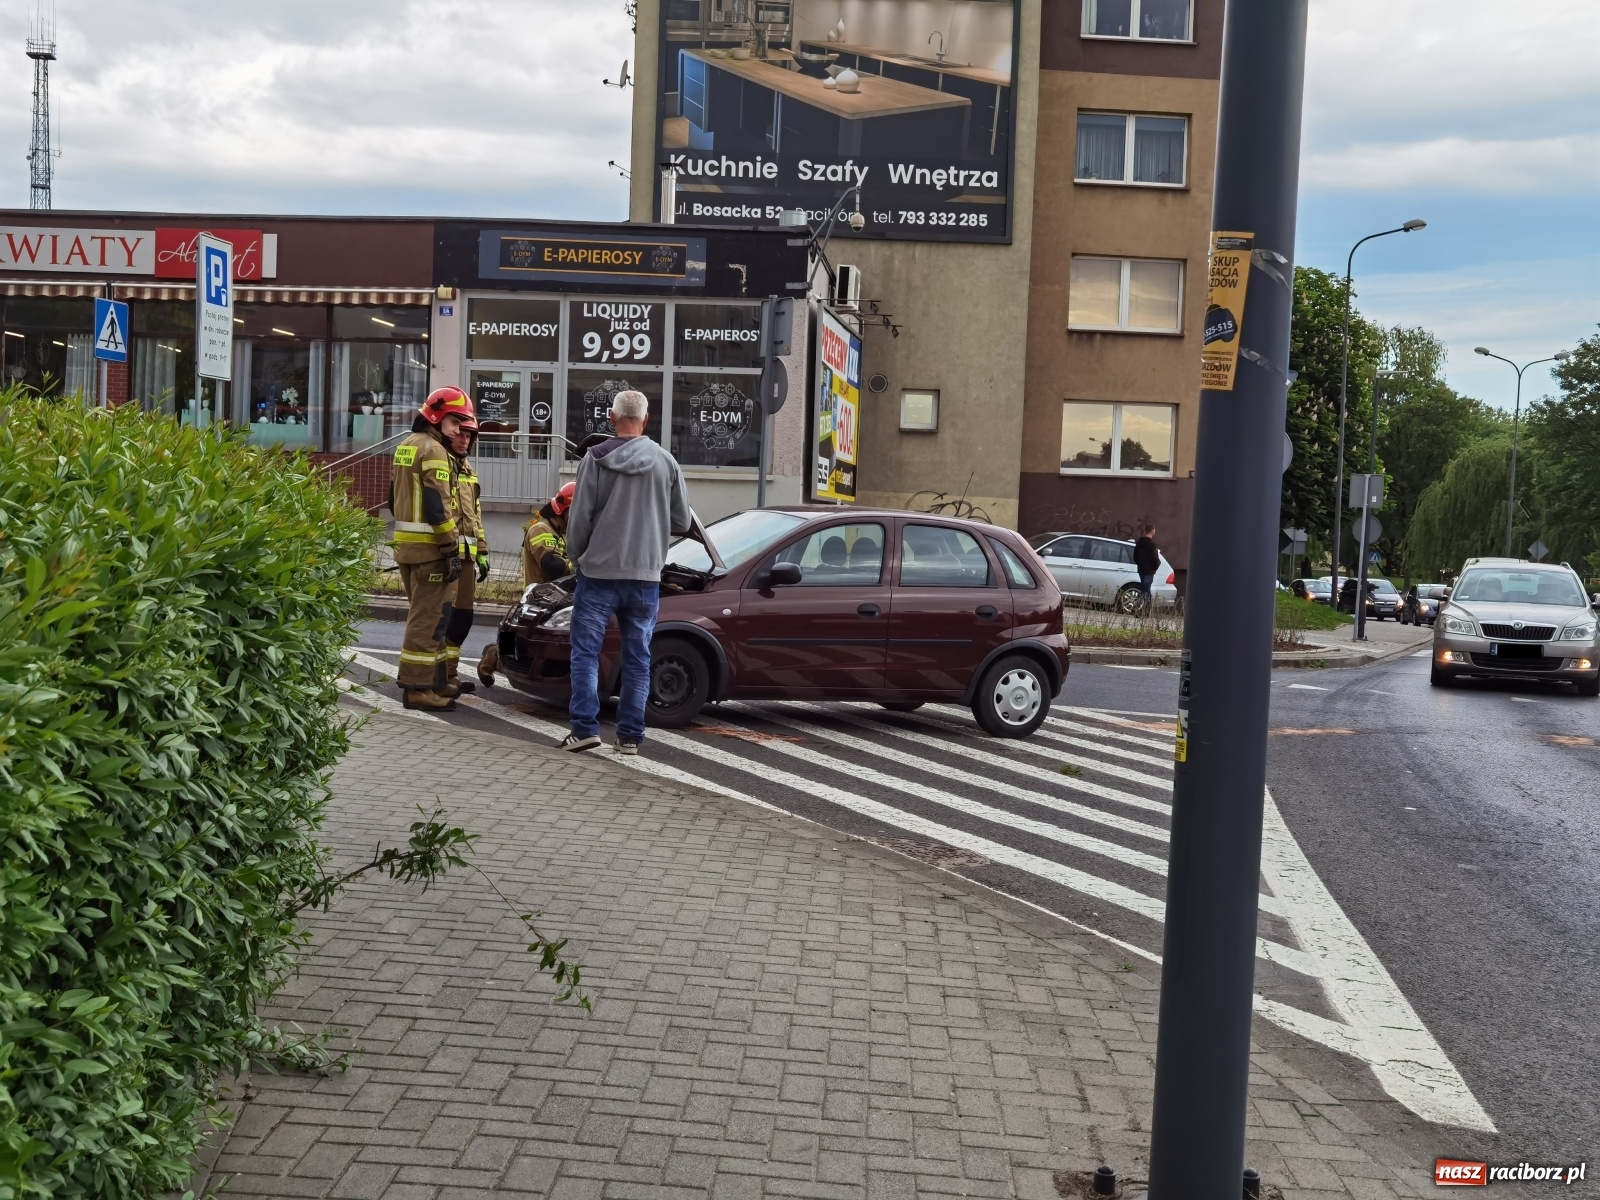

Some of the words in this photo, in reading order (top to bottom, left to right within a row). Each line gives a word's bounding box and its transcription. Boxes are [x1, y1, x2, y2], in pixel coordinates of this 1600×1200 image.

[670, 154, 779, 179] Kuchnie
[797, 159, 869, 188] Szafy
[888, 163, 998, 191] Wnętrza
[692, 203, 762, 219] Bosacka
[873, 210, 894, 224] tel.
[898, 210, 926, 225] 793
[928, 212, 957, 226] 332
[958, 213, 988, 227] 285
[0, 232, 144, 267] WIATY
[513, 250, 531, 258] E-DYM
[543, 247, 643, 265] E-PAPIEROSY
[655, 255, 673, 264] E-DYM
[1213, 256, 1240, 267] SKUP
[1209, 267, 1239, 278] SACJA
[1208, 276, 1239, 288] ZDÓW
[583, 303, 652, 319] LIQUIDY
[468, 322, 558, 337] E-PAPIEROSY
[609, 318, 631, 333] już
[632, 319, 650, 331] od
[582, 331, 652, 363] 9,99
[535, 408, 548, 416] 18+
[700, 410, 742, 423] E-DYM
